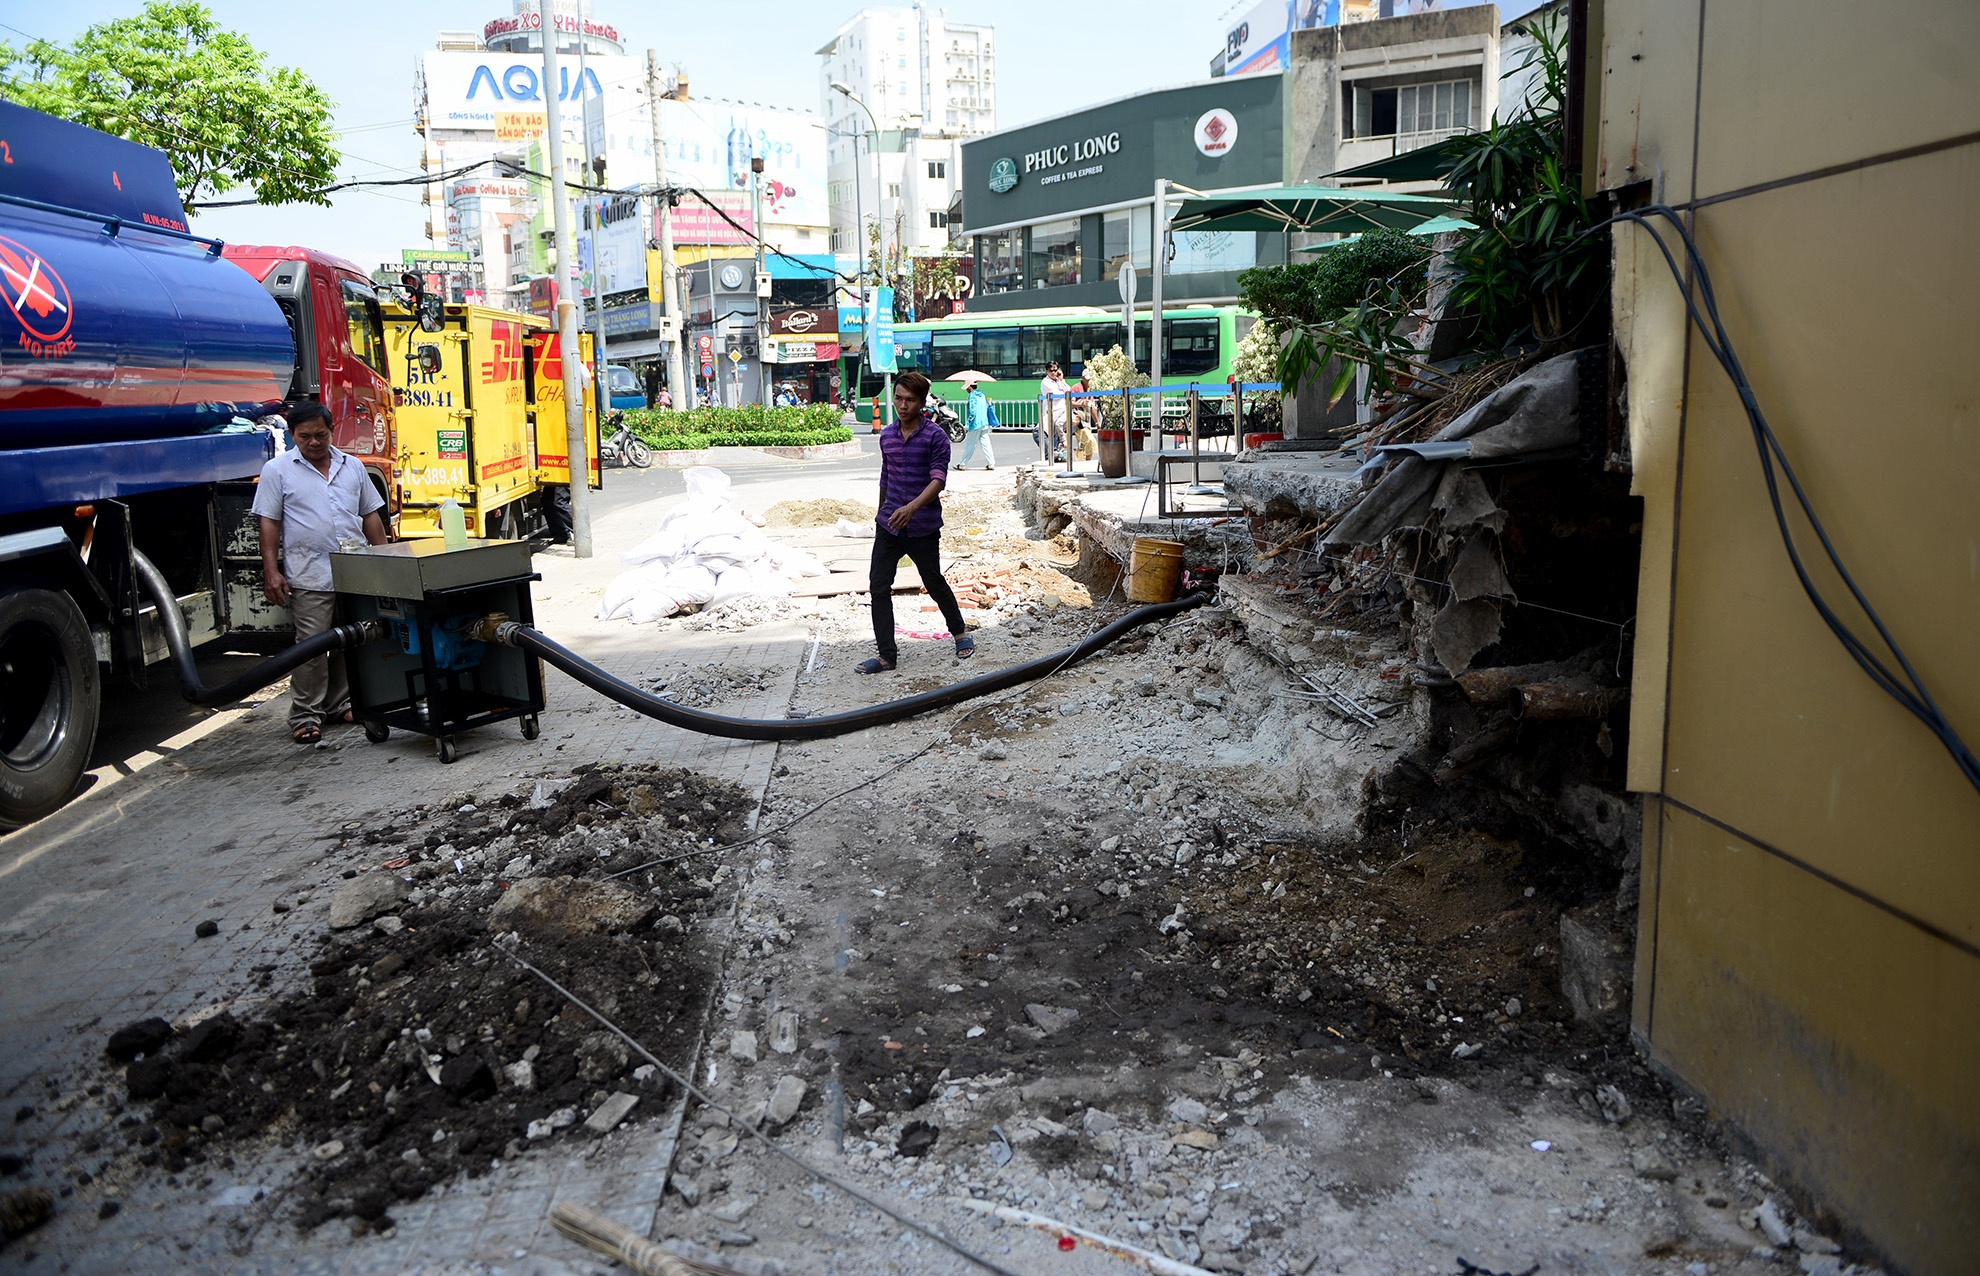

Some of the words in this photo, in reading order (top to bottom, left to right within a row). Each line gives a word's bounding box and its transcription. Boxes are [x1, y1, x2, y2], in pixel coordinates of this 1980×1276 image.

[521, 12, 563, 30] XOY
[1228, 22, 1248, 55] FWD
[466, 65, 603, 101] AQUA
[504, 114, 521, 125] YẾN
[1, 140, 14, 164] 2
[1025, 144, 1069, 173] PHUC
[1074, 132, 1120, 160] LONG
[112, 170, 122, 191] 4
[1040, 174, 1060, 186] COFFEE
[1066, 171, 1078, 180] TEA
[1078, 165, 1104, 178] EXPRESS
[416, 261, 431, 270] THẾ
[433, 261, 448, 272] GIỚI
[18, 331, 42, 358] NO
[44, 334, 77, 360] FIRE
[404, 390, 453, 407] 389.41
[536, 386, 566, 402] CHA
